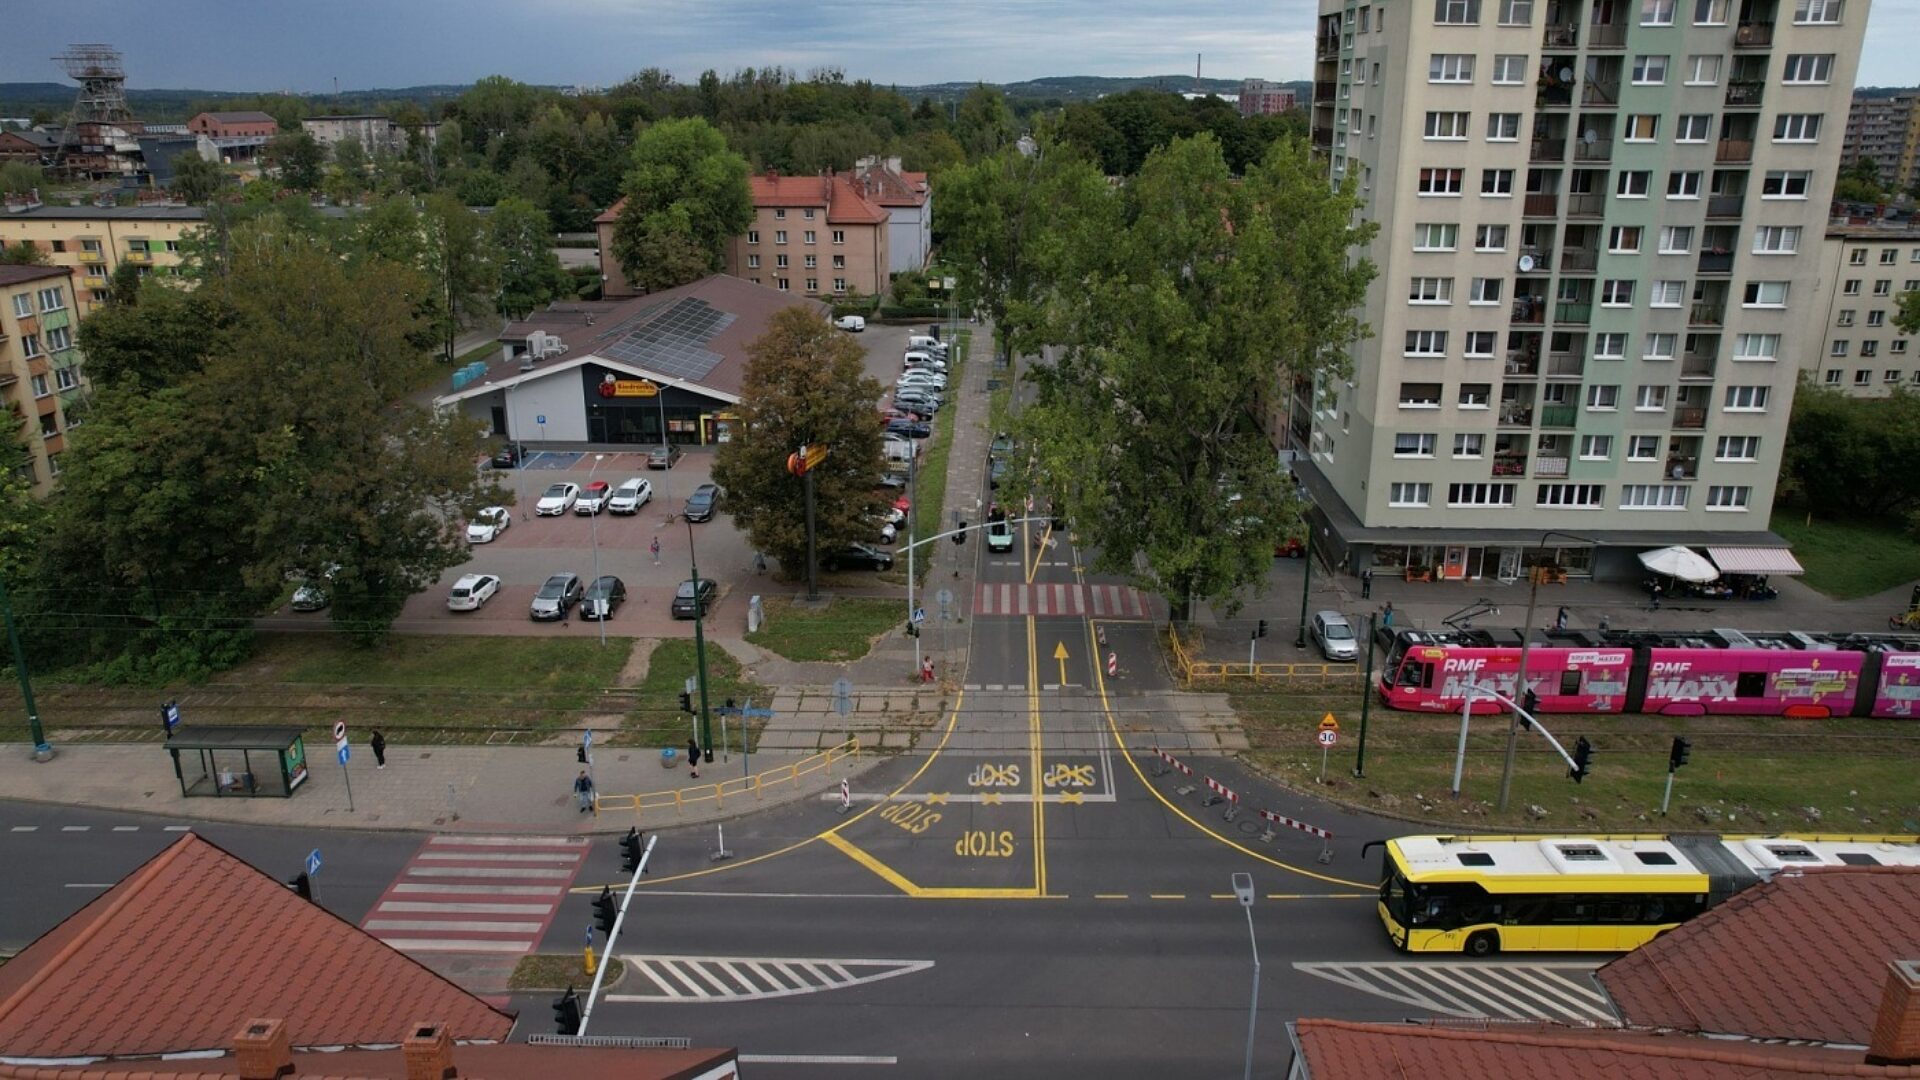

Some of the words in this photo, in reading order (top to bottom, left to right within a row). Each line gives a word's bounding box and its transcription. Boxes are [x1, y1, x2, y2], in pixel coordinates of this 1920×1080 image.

[1443, 658, 1487, 672] RMF
[1648, 675, 1738, 702] MAXX
[1320, 732, 1335, 742] 30
[967, 764, 1020, 787] STOP
[1043, 763, 1097, 787] STOP
[879, 801, 942, 834] STOP
[955, 831, 1014, 858] STOP
